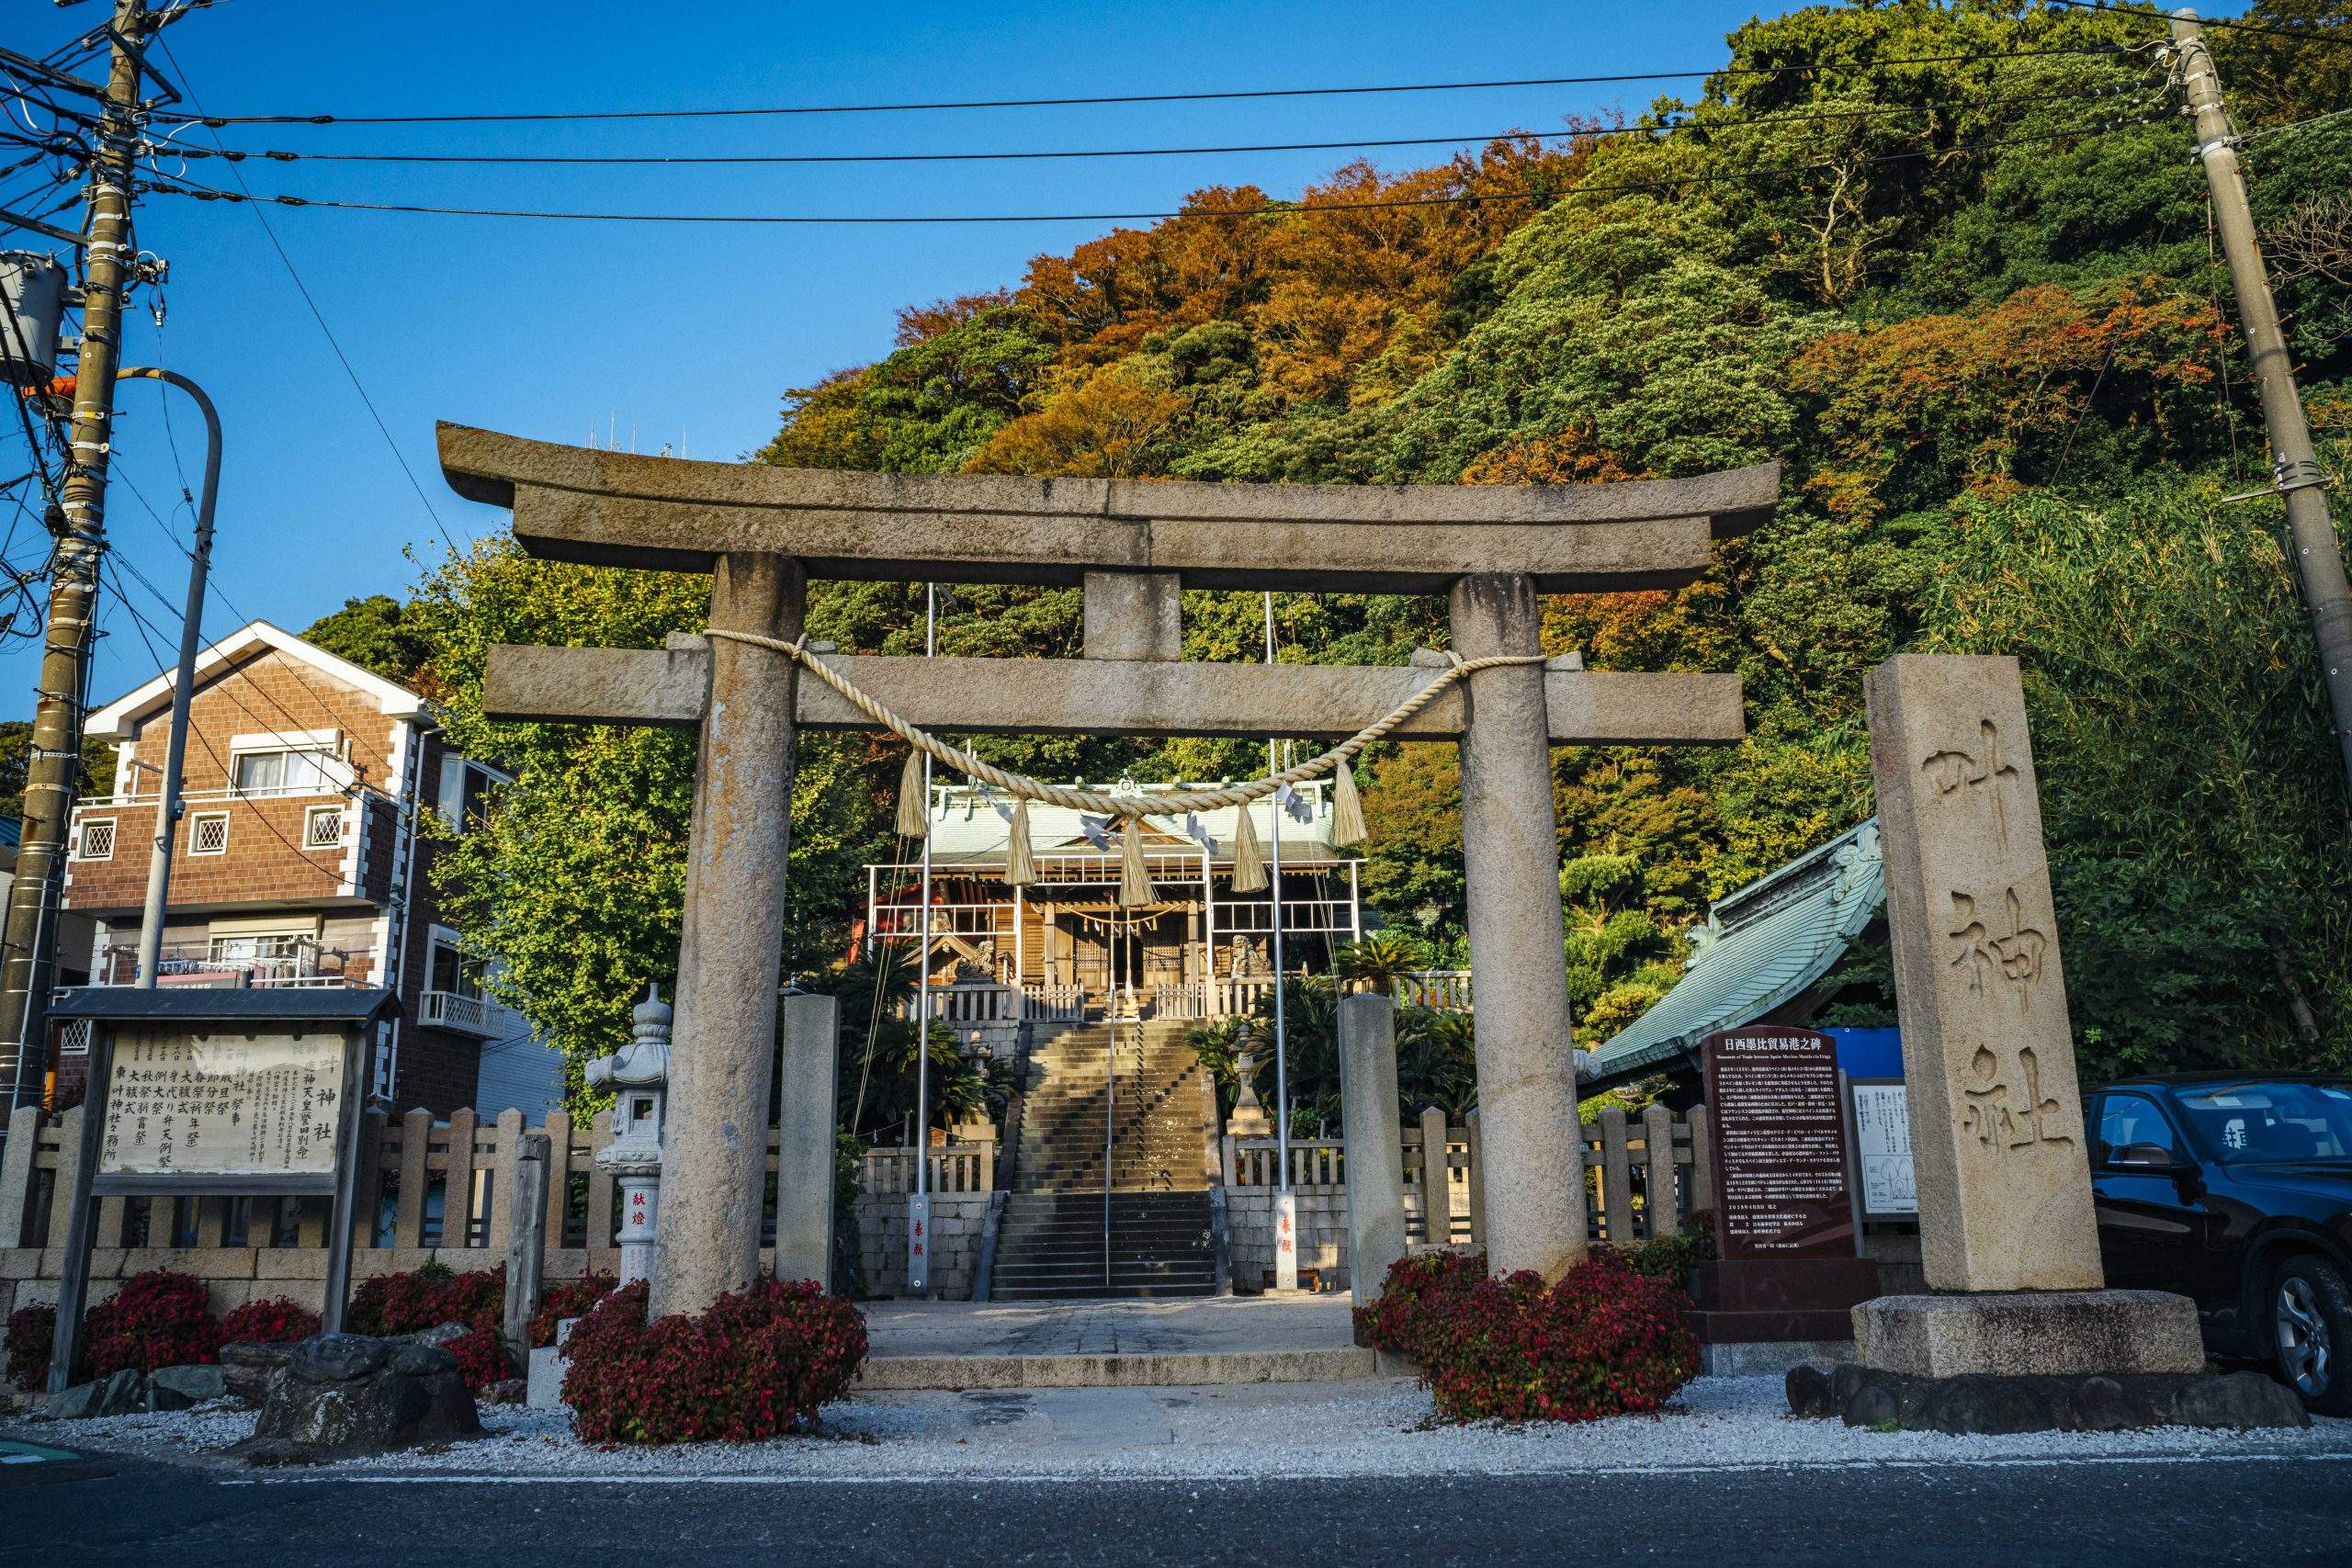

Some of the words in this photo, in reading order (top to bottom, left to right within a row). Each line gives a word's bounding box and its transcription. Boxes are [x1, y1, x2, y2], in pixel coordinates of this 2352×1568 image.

[1724, 1037, 1822, 1051] 日西墨比貿易港之碑
[103, 1065, 126, 1161] 東叶神社々務所
[152, 1070, 167, 1115] 例大祭
